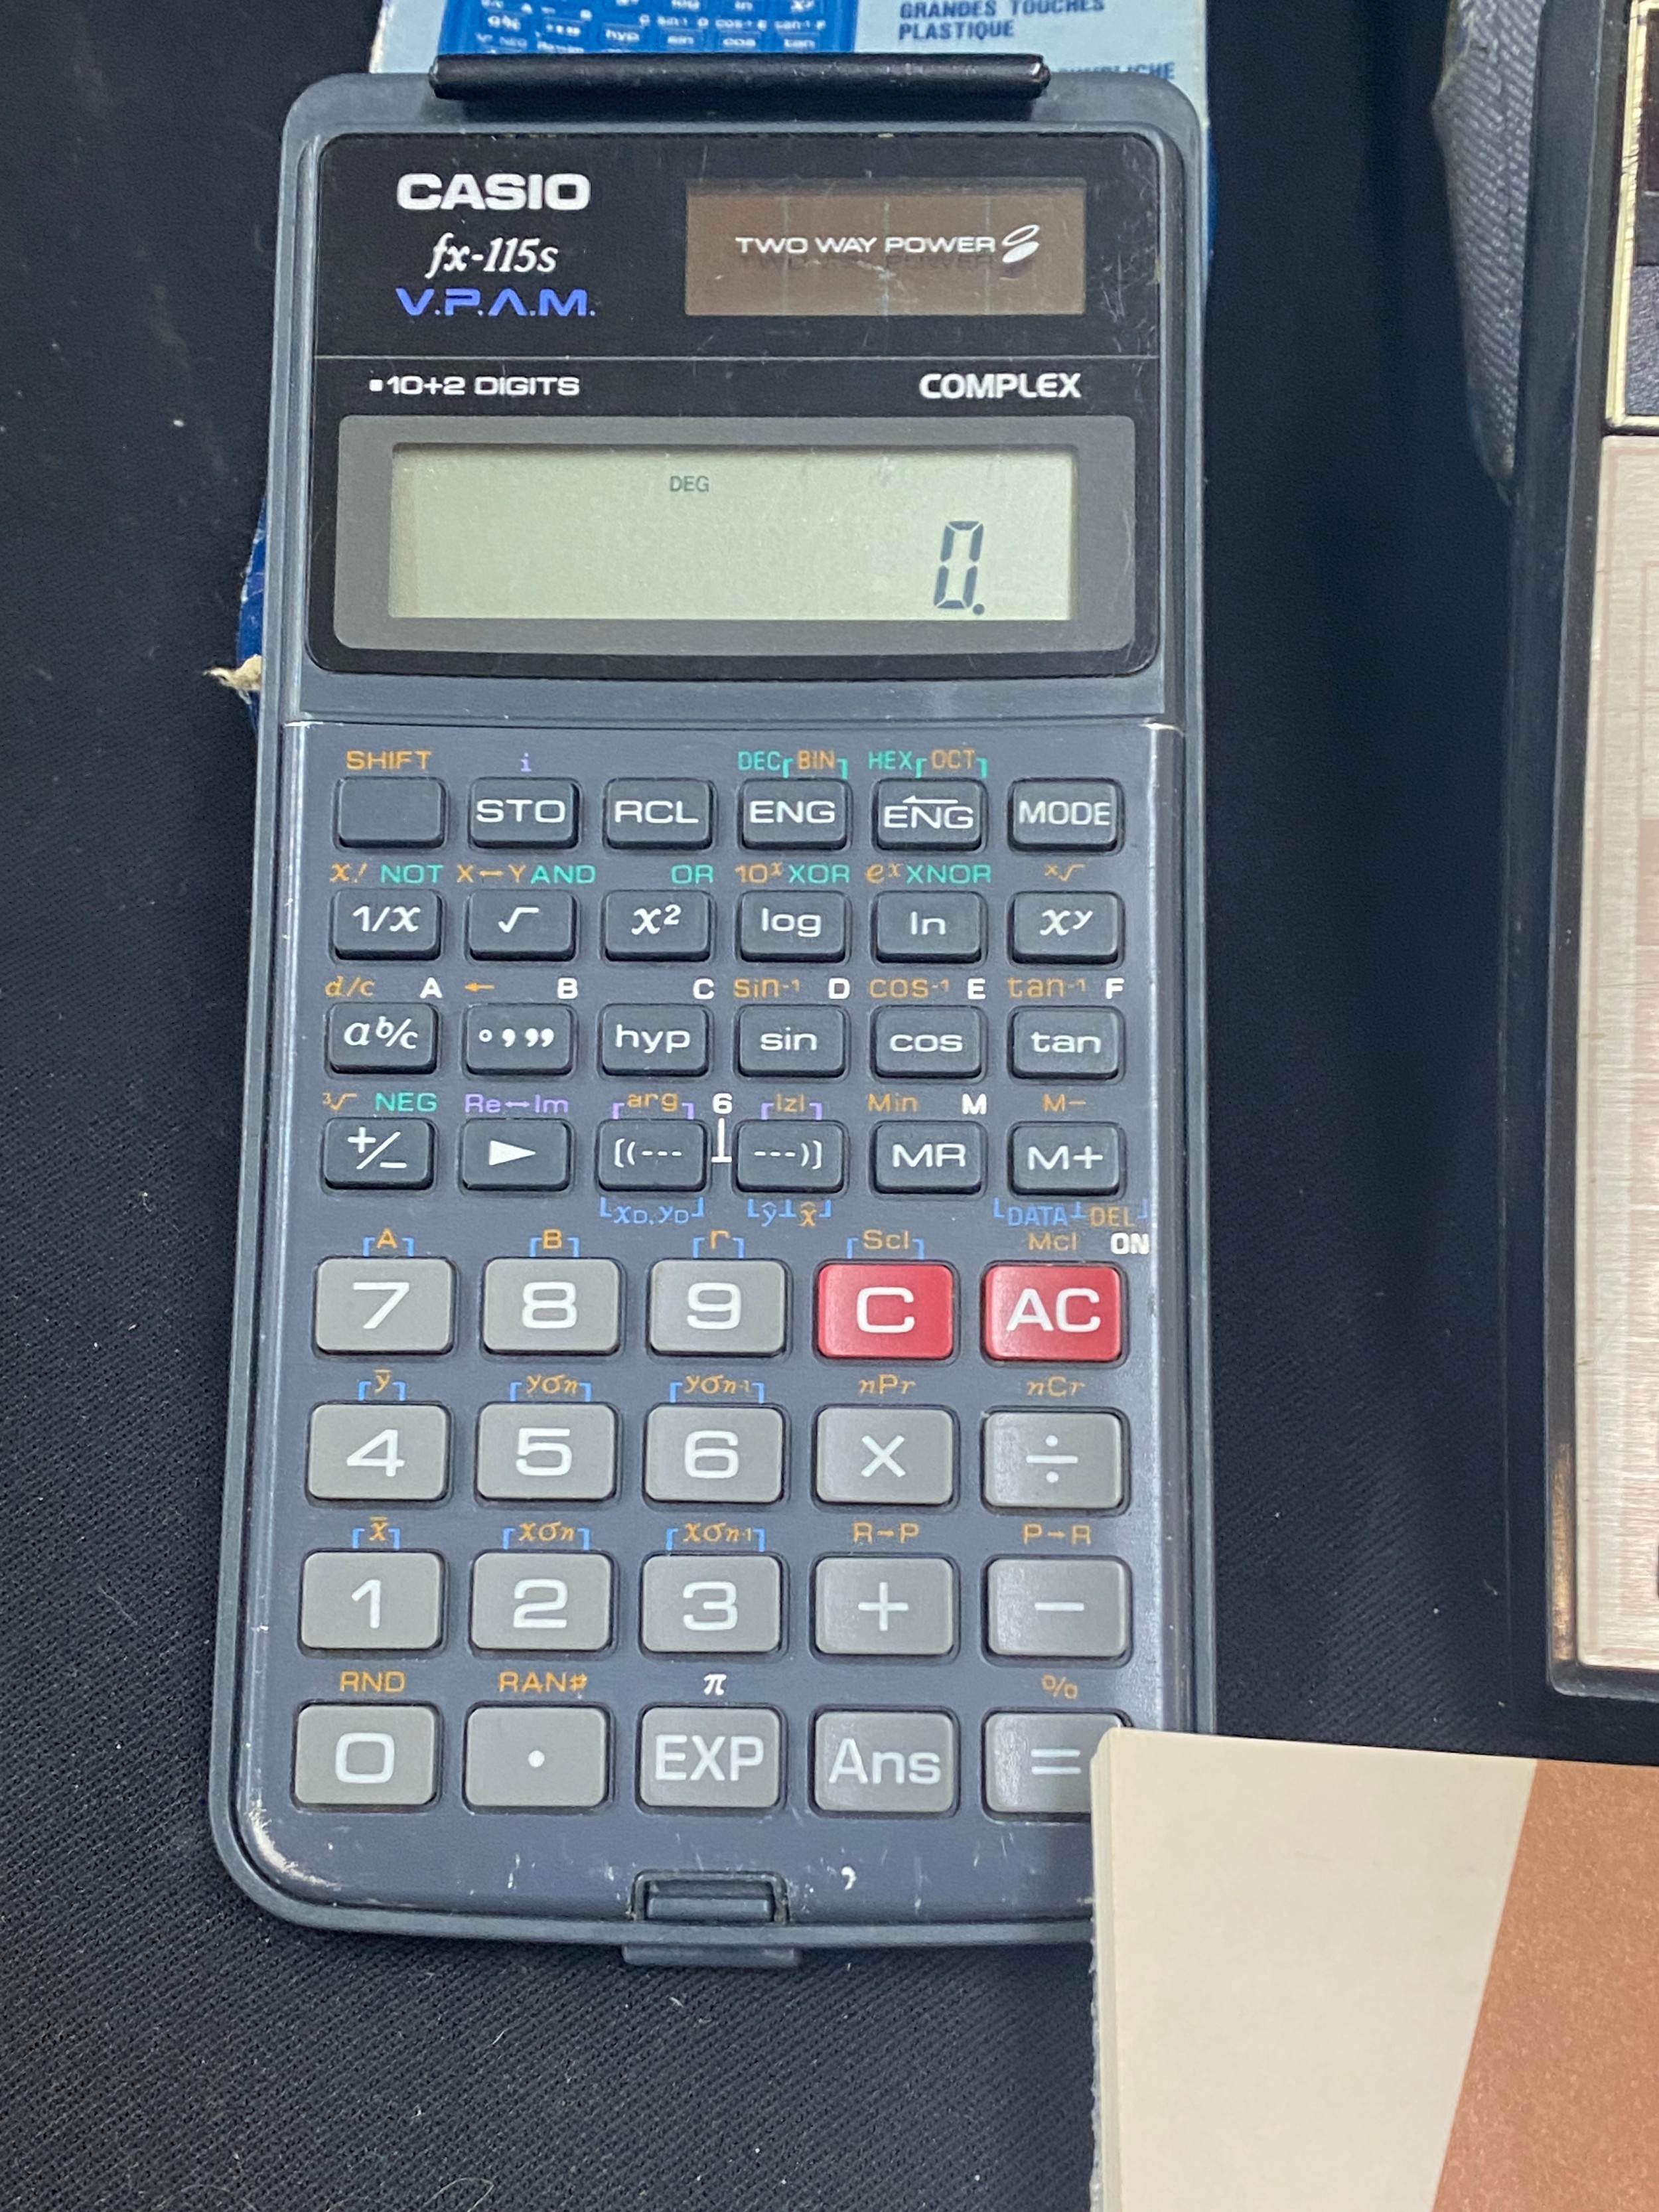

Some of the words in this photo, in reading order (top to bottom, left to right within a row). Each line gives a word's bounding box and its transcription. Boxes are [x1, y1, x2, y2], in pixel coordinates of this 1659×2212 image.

[900, 0, 997, 19] GRANDES
[1011, 0, 1105, 16] TOUCHES
[899, 19, 1015, 40] PLASTIQUE
[396, 173, 591, 211] CASIO
[424, 232, 559, 279] fx-115s
[735, 236, 809, 254] TWO
[815, 236, 878, 254] WAY
[885, 236, 996, 254] POWER
[386, 376, 466, 396] 10+2
[474, 376, 581, 396] DIGITS
[918, 372, 1083, 400] COMPLEX
[669, 475, 710, 492] DEG
[346, 750, 433, 771] SHIFT
[737, 751, 780, 771] DEC
[798, 749, 835, 770] BIN
[868, 751, 912, 770] HEX
[932, 749, 975, 770] OCT
[476, 798, 566, 824] STO
[614, 799, 700, 824] RCL
[749, 800, 836, 824] ENG
[883, 804, 974, 830] ENG
[1018, 800, 1112, 826] MODE
[380, 864, 444, 884] NOT
[530, 864, 596, 884] AND
[670, 864, 714, 884] OR
[788, 865, 851, 884] XOR
[906, 865, 992, 884] XNOR
[760, 907, 822, 938] log
[419, 977, 443, 999] A
[556, 978, 579, 999] B
[693, 978, 715, 999] C
[828, 978, 851, 999] D
[967, 978, 986, 1000] E
[1106, 978, 1125, 999] F
[615, 1024, 691, 1055] hyp
[760, 1027, 819, 1052] sin
[889, 1032, 964, 1054] cos
[1031, 1031, 1102, 1054] tan
[374, 1092, 438, 1113] NEG
[626, 1092, 679, 1113] arg
[868, 1094, 919, 1113] Min
[962, 1094, 987, 1115] M
[891, 1143, 967, 1168] MR
[1027, 1145, 1104, 1171] M+
[1007, 1206, 1068, 1226] DATA
[1089, 1207, 1135, 1228] DEL
[376, 1228, 397, 1250] A
[543, 1228, 563, 1250] B
[1110, 1232, 1150, 1255] ON
[352, 1281, 411, 1329] 7
[521, 1281, 578, 1329] 8
[686, 1282, 743, 1330] 9
[856, 1286, 916, 1334] C
[1006, 1288, 1102, 1333] AC
[346, 1428, 406, 1477] 4
[514, 1428, 574, 1477] 5
[684, 1430, 741, 1480] 6
[350, 1578, 382, 1630] 1
[512, 1578, 569, 1629] 2
[682, 1580, 739, 1632] 3
[339, 1670, 406, 1692] RND
[498, 1671, 588, 1693] RAN#
[1041, 1674, 1078, 1700] %
[654, 1734, 765, 1783] EXP
[828, 1737, 942, 1786] Ans
